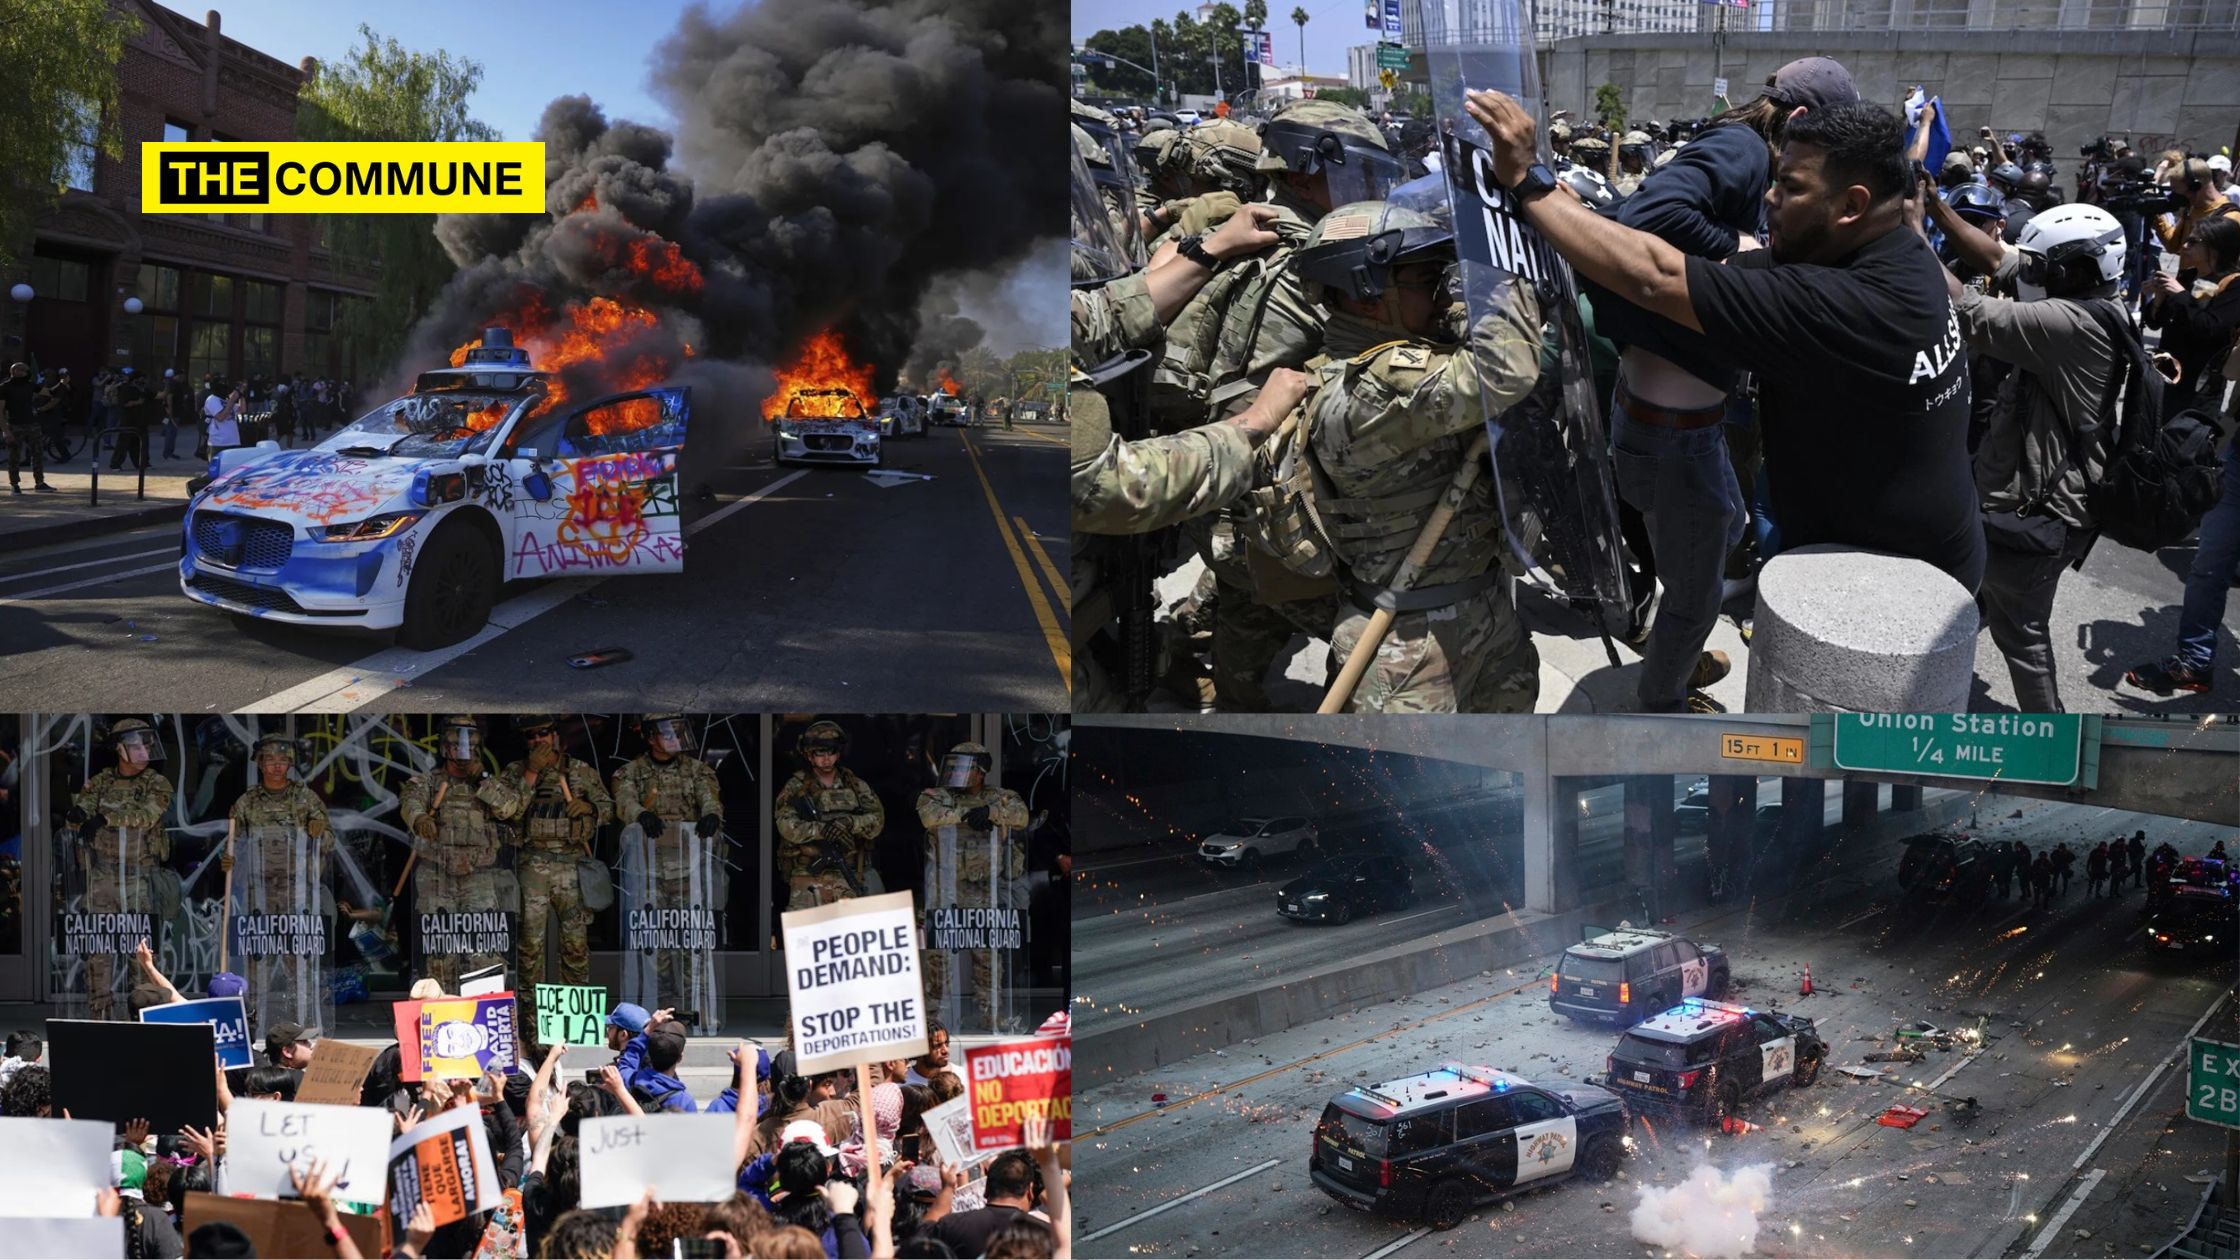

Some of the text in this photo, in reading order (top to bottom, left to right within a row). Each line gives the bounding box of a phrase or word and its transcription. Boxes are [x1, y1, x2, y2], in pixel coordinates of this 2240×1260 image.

[1859, 713, 2055, 738] Union Station
[1728, 739, 1798, 758] 15 FT 1 IN
[1912, 736, 2004, 764] 1/4 MILE
[64, 913, 152, 934] CALIFORNIA
[237, 915, 325, 936] CALIFORNIA
[421, 912, 509, 934] CALIFORNIA
[628, 909, 717, 931] CALIFORNIA
[934, 908, 1020, 930] CALIFORNIA
[65, 934, 118, 954] NATIONAL
[238, 935, 326, 957] NATIONAL GUARD
[422, 932, 510, 954] NATIONAL GUARD
[629, 929, 717, 951] NATIONAL GUARD
[813, 925, 909, 963] PEOPLE
[935, 928, 1021, 950] NATIONAL GUARD
[797, 953, 911, 990] DEMAND:
[537, 987, 606, 1015] ICE OUT
[486, 1006, 499, 1056] AVID
[541, 1014, 552, 1037] OF
[565, 1014, 600, 1045] LA
[801, 998, 916, 1038] STOP THE
[422, 1012, 433, 1073] FREE
[496, 1004, 514, 1068] HUERTA
[803, 1024, 917, 1055] DEPORTATIONS!
[976, 1079, 1002, 1104] NO
[1643, 1082, 1669, 1095] PATROL
[2198, 1084, 2237, 1113] 2B
[260, 1111, 315, 1137] LET
[421, 1163, 435, 1204] TIENE
[433, 1163, 446, 1195] QUE
[439, 1137, 462, 1216] LARGARSE
